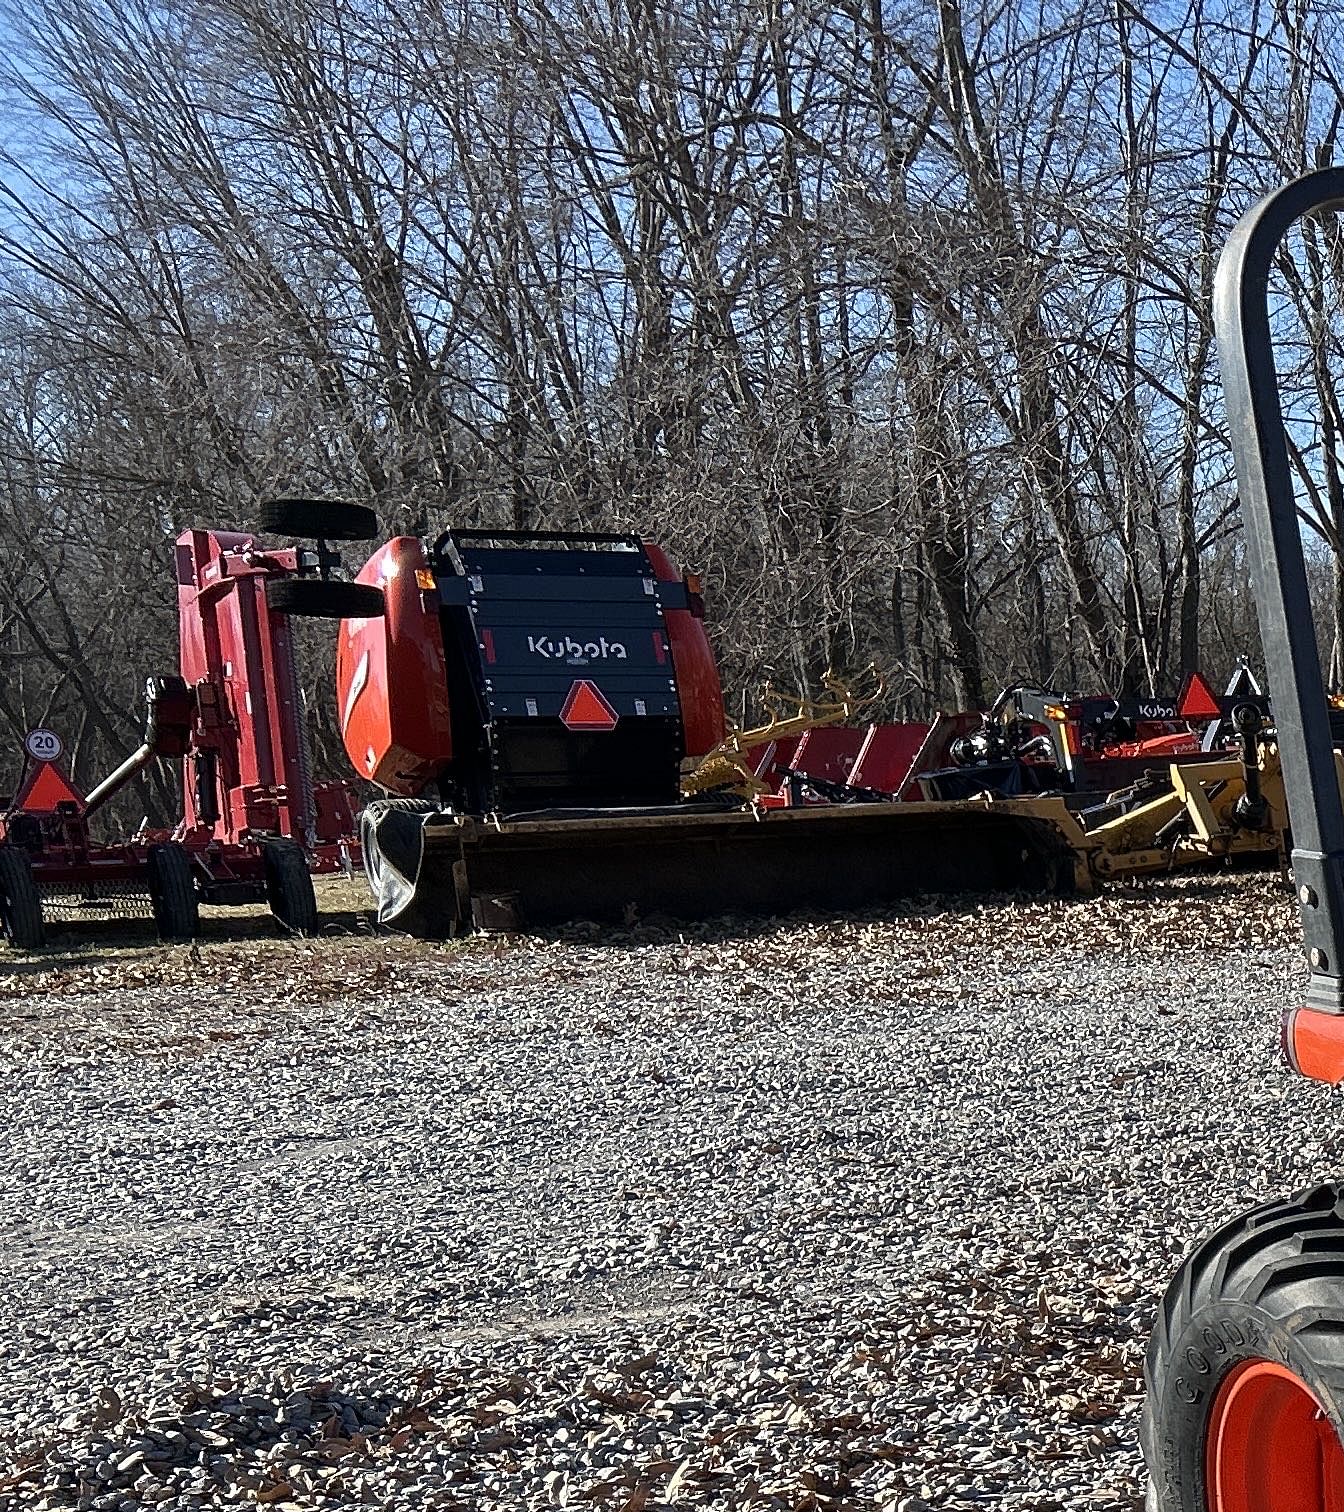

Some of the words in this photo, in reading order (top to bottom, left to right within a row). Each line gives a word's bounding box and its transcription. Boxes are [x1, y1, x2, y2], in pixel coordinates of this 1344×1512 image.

[527, 635, 627, 659] Kubota
[1138, 703, 1178, 719] Kubot
[33, 735, 55, 749] 20
